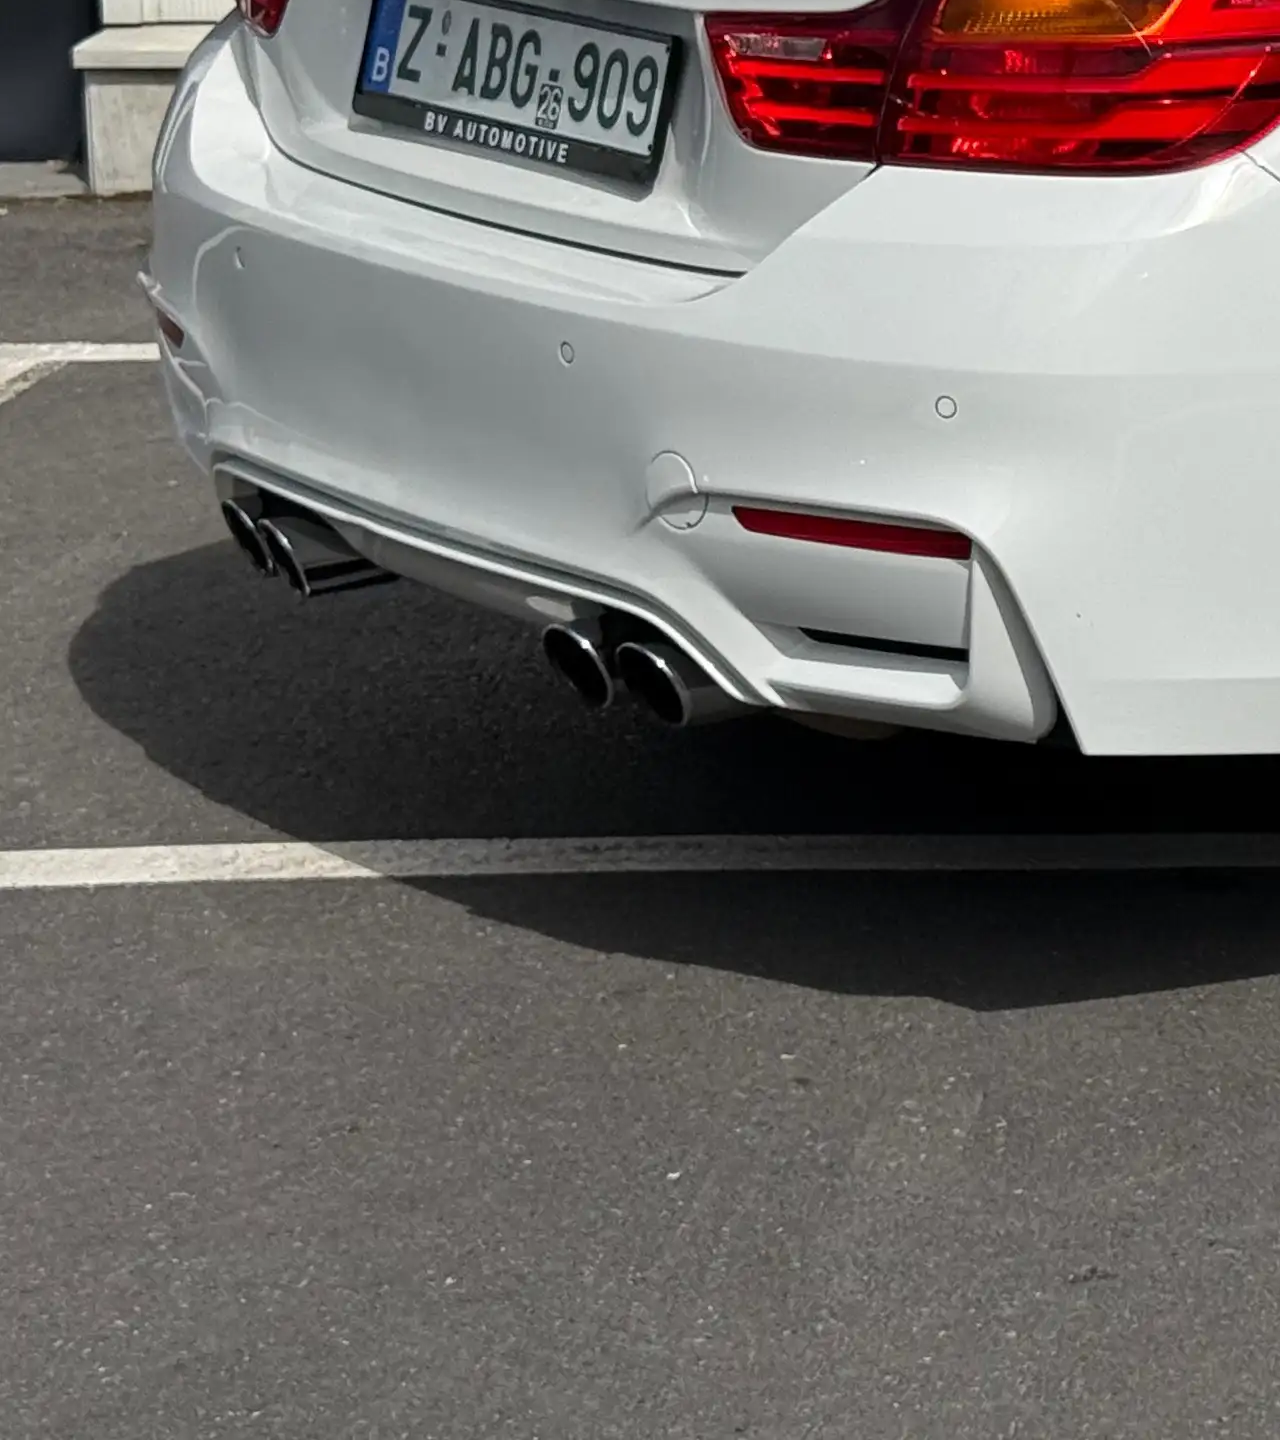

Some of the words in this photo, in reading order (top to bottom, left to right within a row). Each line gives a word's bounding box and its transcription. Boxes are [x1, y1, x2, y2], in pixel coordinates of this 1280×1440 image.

[371, 46, 390, 82] B
[536, 85, 563, 121] 26
[424, 111, 448, 134] BV
[452, 119, 570, 164] AUTOMOTIVE
